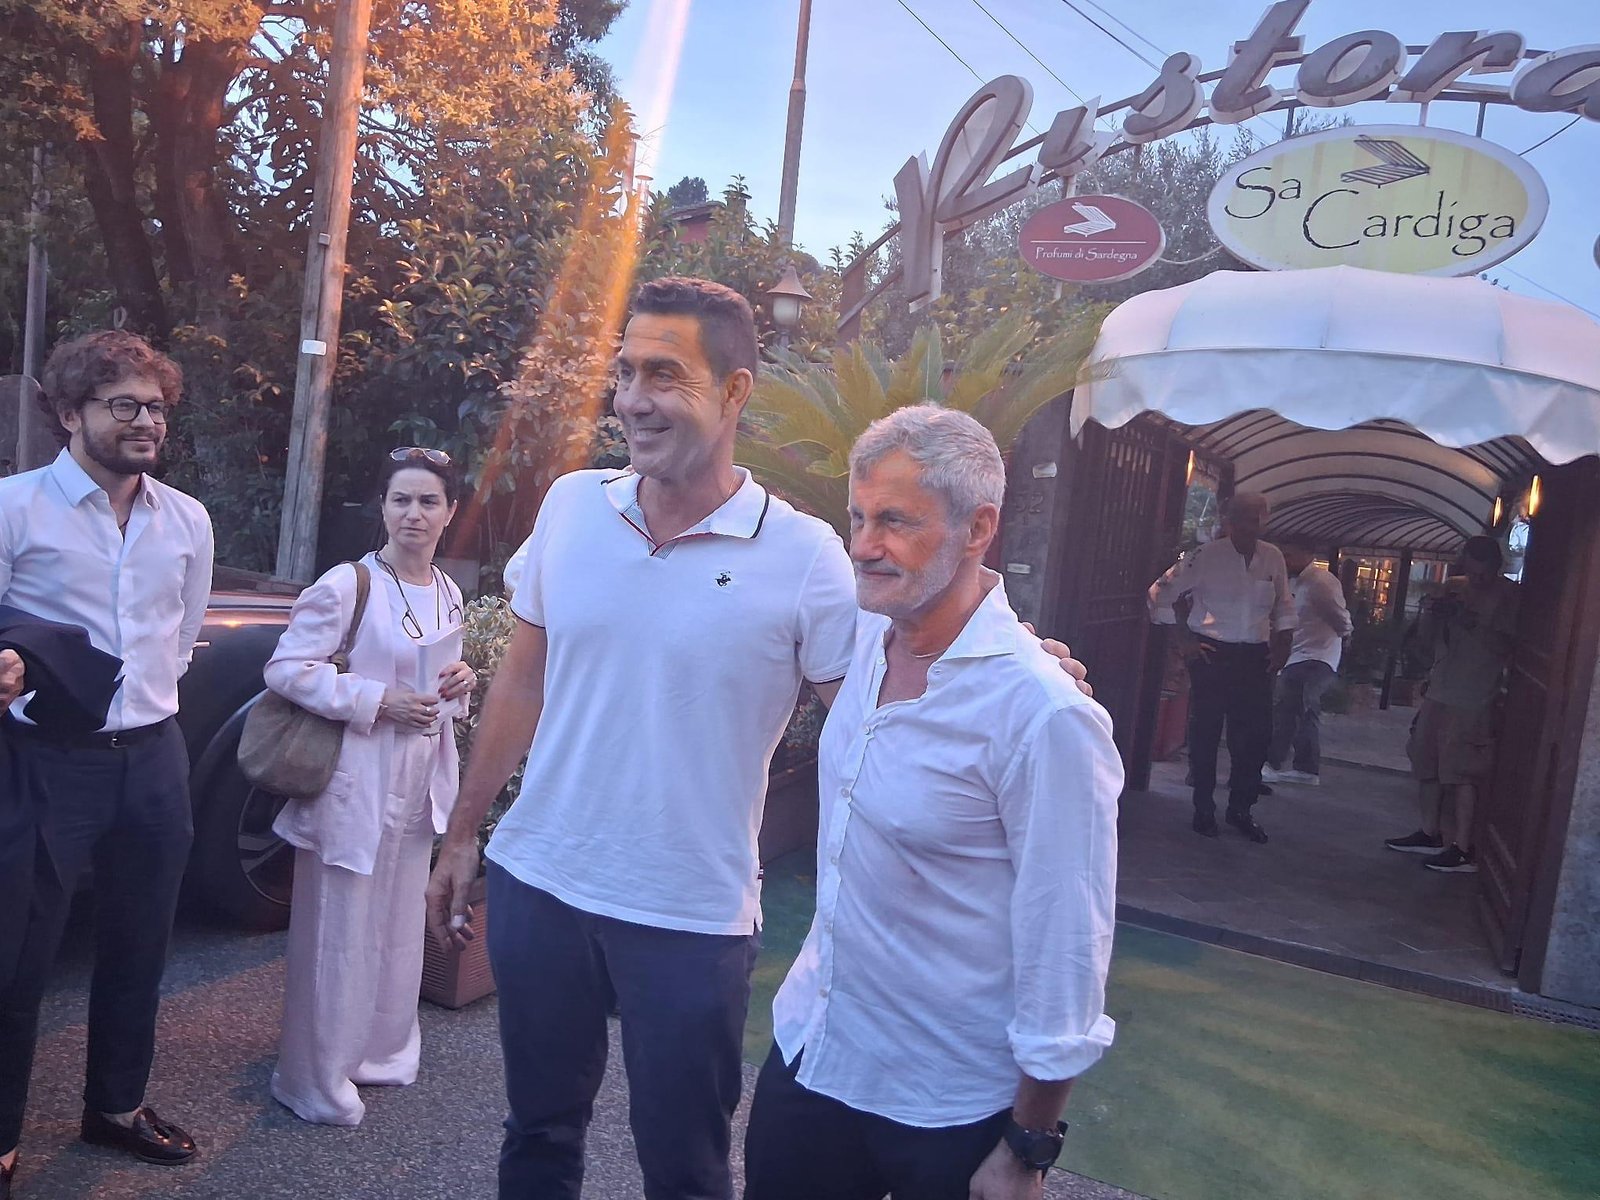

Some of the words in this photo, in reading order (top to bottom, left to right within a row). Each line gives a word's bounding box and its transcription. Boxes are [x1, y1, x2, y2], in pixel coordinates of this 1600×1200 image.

[1223, 166, 1301, 219] Sa
[1302, 189, 1515, 257] Cardiga
[1035, 246, 1073, 260] Profumi
[1074, 247, 1084, 259] di
[1085, 247, 1138, 263] Sardegna
